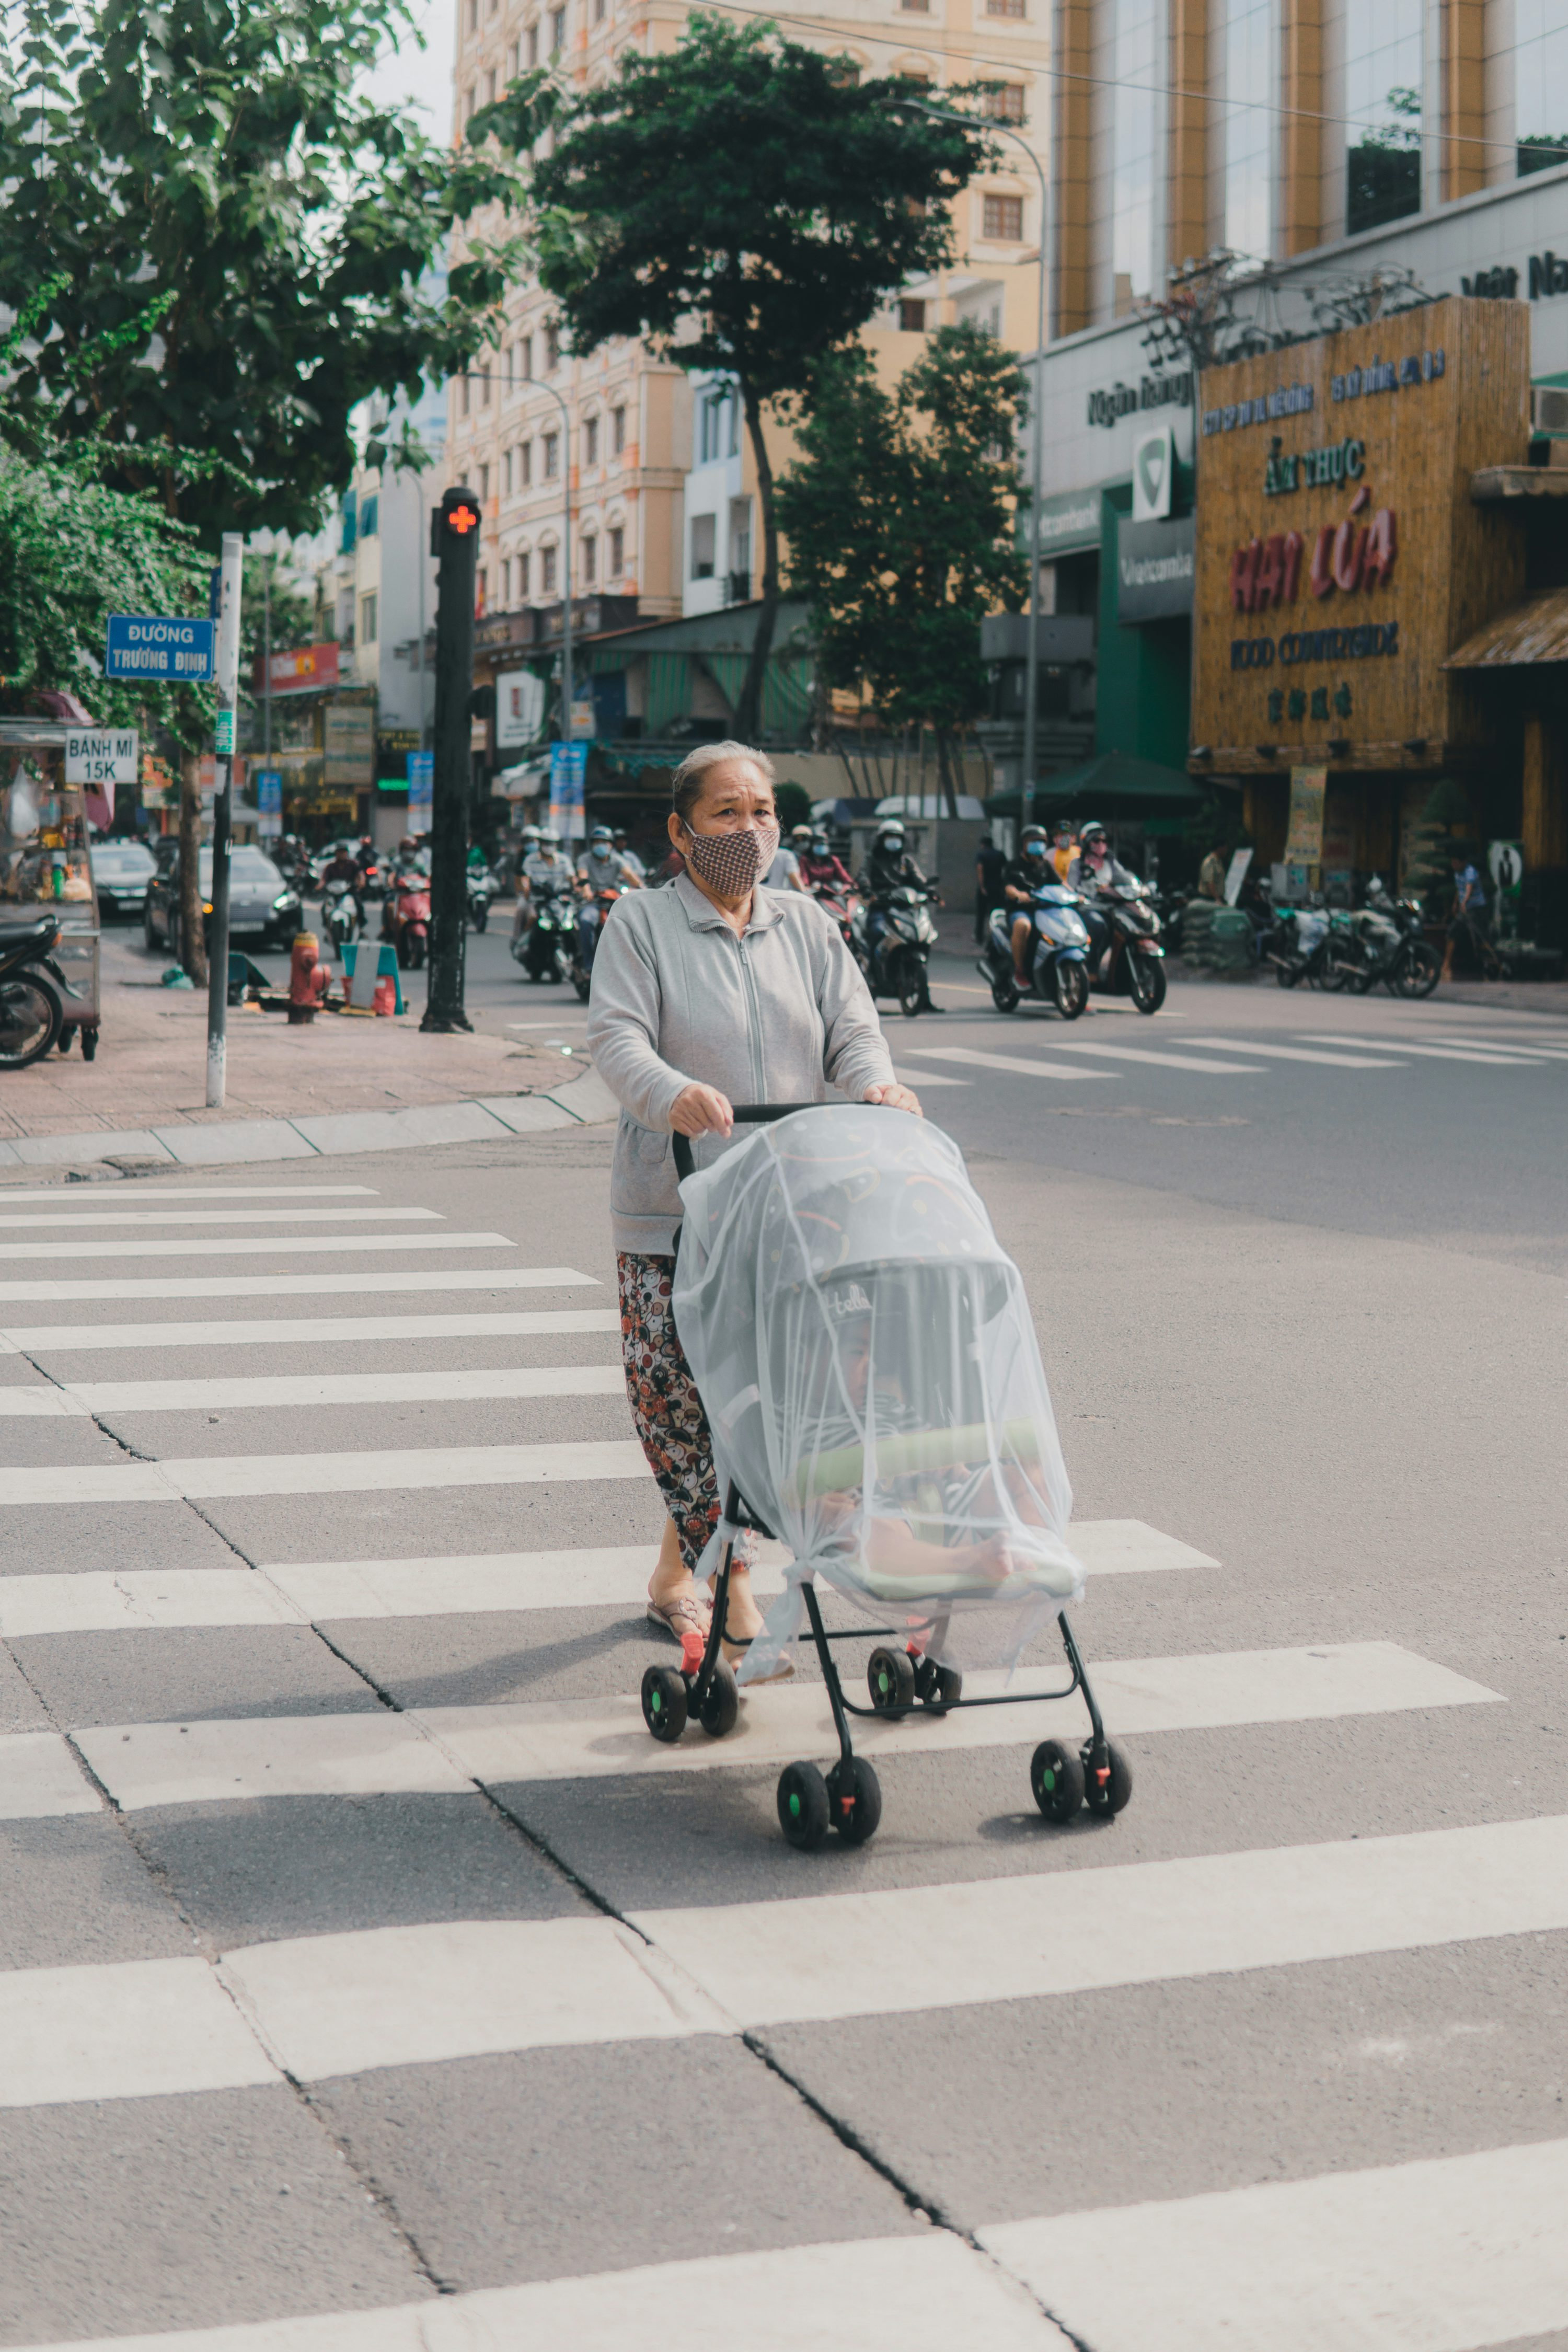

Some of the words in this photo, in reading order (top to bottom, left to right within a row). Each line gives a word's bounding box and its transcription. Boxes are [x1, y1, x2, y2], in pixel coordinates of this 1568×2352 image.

[128, 622, 194, 644] ĐƯỜNG
[113, 647, 168, 670] TRƯƠNG
[175, 651, 207, 675] ĐỊNH
[70, 735, 111, 757] BÁNH
[117, 736, 133, 757] MÌ
[85, 761, 116, 779] 15K
